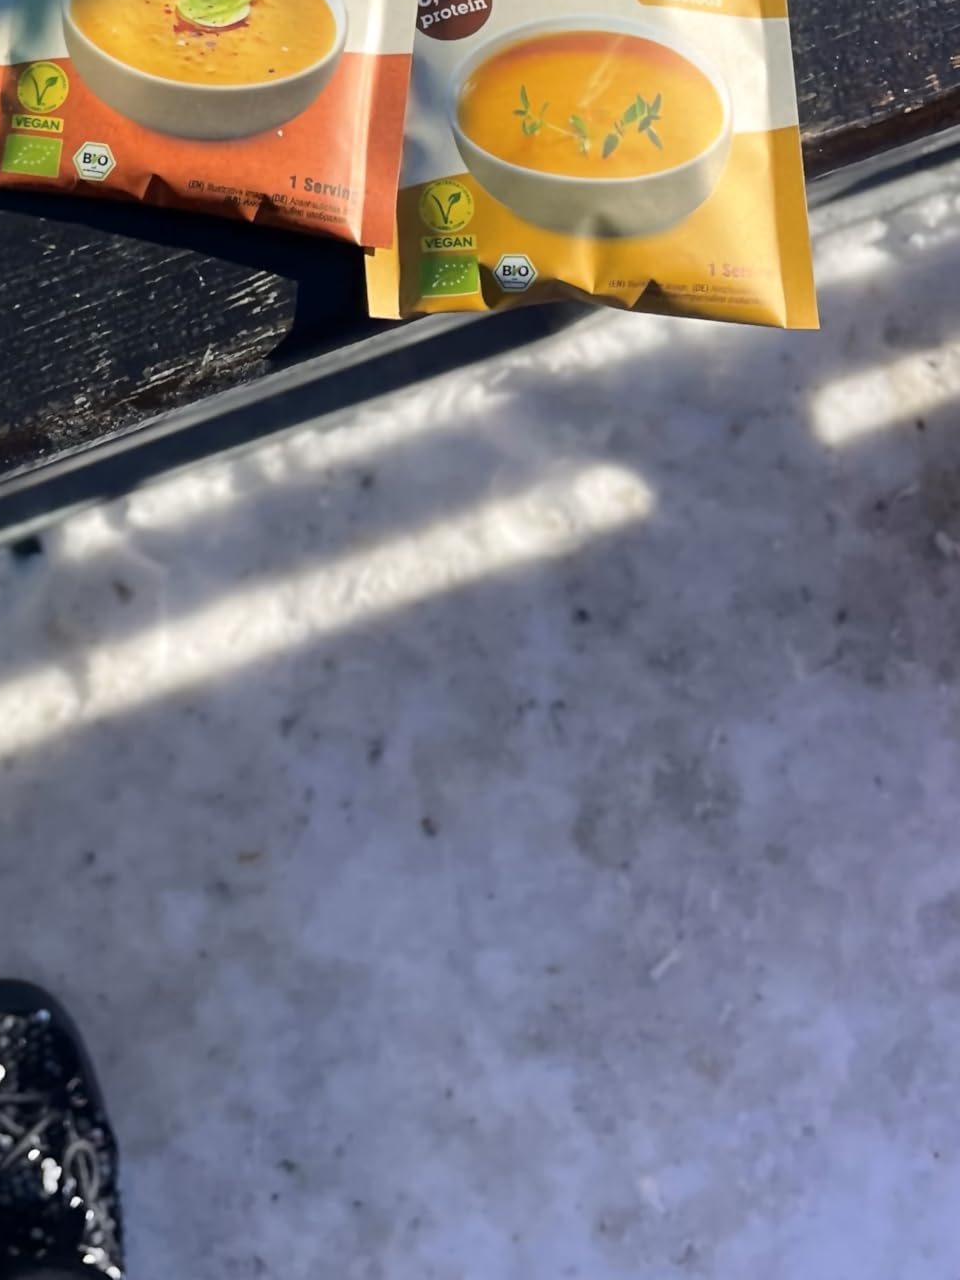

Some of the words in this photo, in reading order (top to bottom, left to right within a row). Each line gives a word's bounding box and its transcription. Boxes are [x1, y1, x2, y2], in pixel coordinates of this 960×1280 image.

[15, 116, 60, 131] VEGAN
[290, 175, 297, 189] 1
[425, 236, 473, 249] VEGAN
